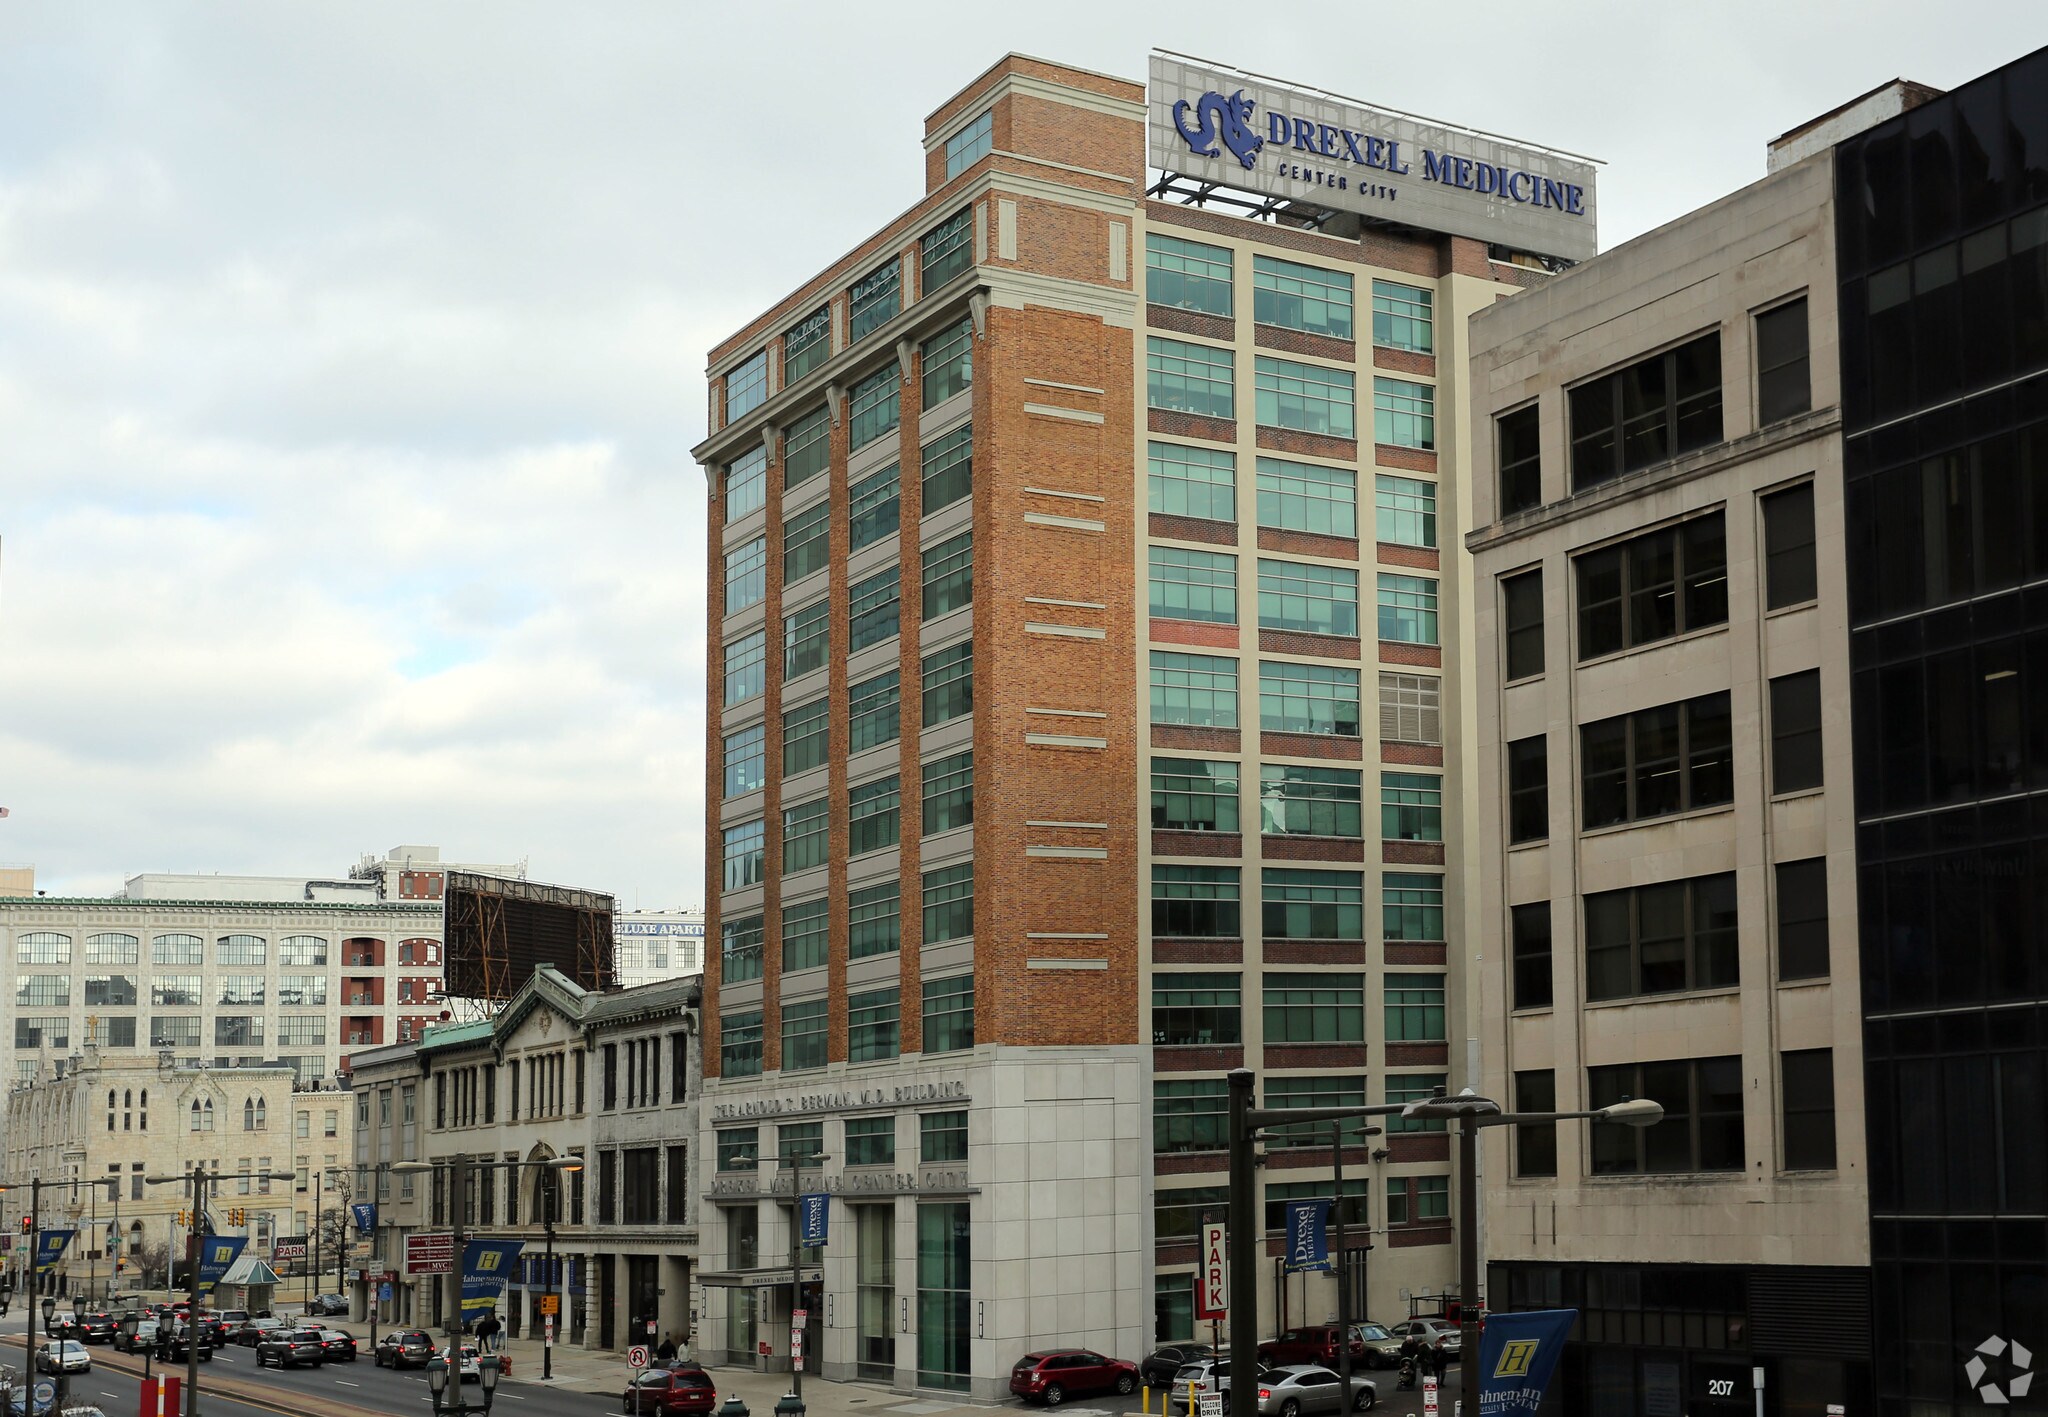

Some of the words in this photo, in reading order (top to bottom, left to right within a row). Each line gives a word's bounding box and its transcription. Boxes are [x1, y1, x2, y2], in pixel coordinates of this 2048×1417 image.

[1267, 111, 1409, 175] DREXEL
[1422, 149, 1586, 216] MEDICINE
[1279, 162, 1348, 191] CENTER
[1359, 181, 1398, 201] CITY
[714, 1103, 735, 1118] THE
[738, 1099, 782, 1116] ARNOLD
[894, 1080, 965, 1101] BUILDING
[711, 1178, 759, 1194] DREXEL
[852, 1172, 918, 1190] CENTER
[926, 1170, 969, 1189] CITY
[808, 1197, 818, 1238] Drexel
[1307, 1204, 1318, 1259] MEDICINE
[1295, 1205, 1311, 1263] Drexel
[278, 1246, 305, 1256] PARK
[480, 1253, 497, 1268] H
[776, 1274, 804, 1282] MEDICE
[1209, 1229, 1223, 1306] PARK
[1499, 1344, 1534, 1372] H
[1708, 1379, 1735, 1396] 207
[1201, 1401, 1221, 1409] WELCOME
[1202, 1409, 1221, 1417] DRIVE
